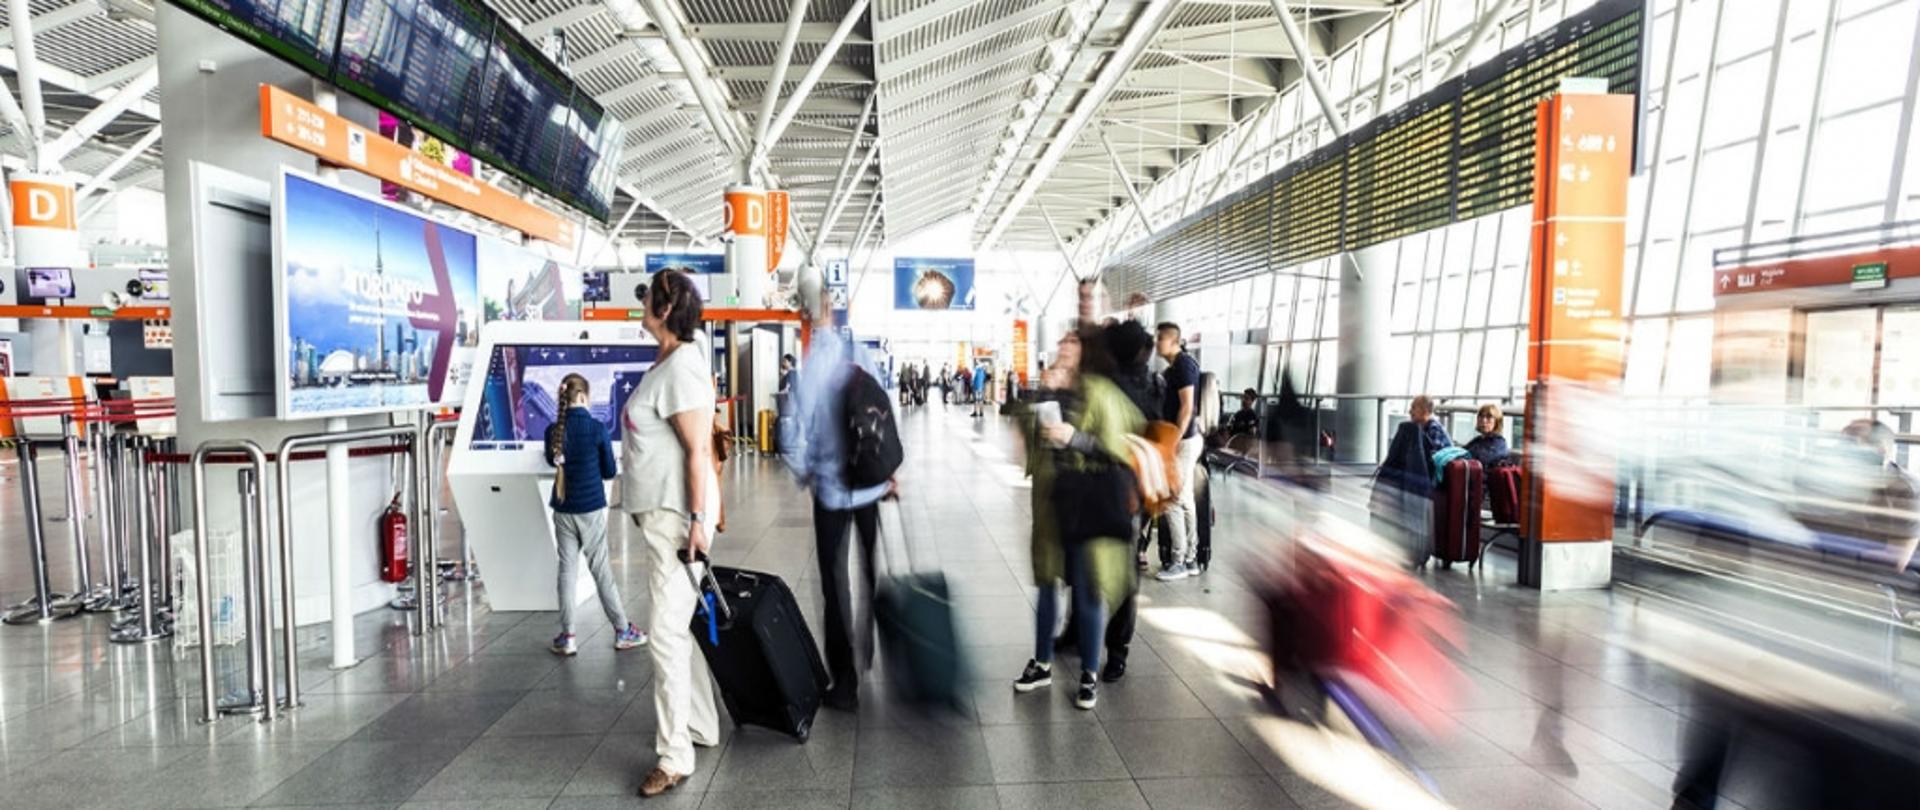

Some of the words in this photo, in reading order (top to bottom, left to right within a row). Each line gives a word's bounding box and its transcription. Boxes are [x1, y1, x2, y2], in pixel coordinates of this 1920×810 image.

[29, 188, 59, 221] D
[747, 199, 763, 229] D
[348, 272, 423, 305] TORONTO
